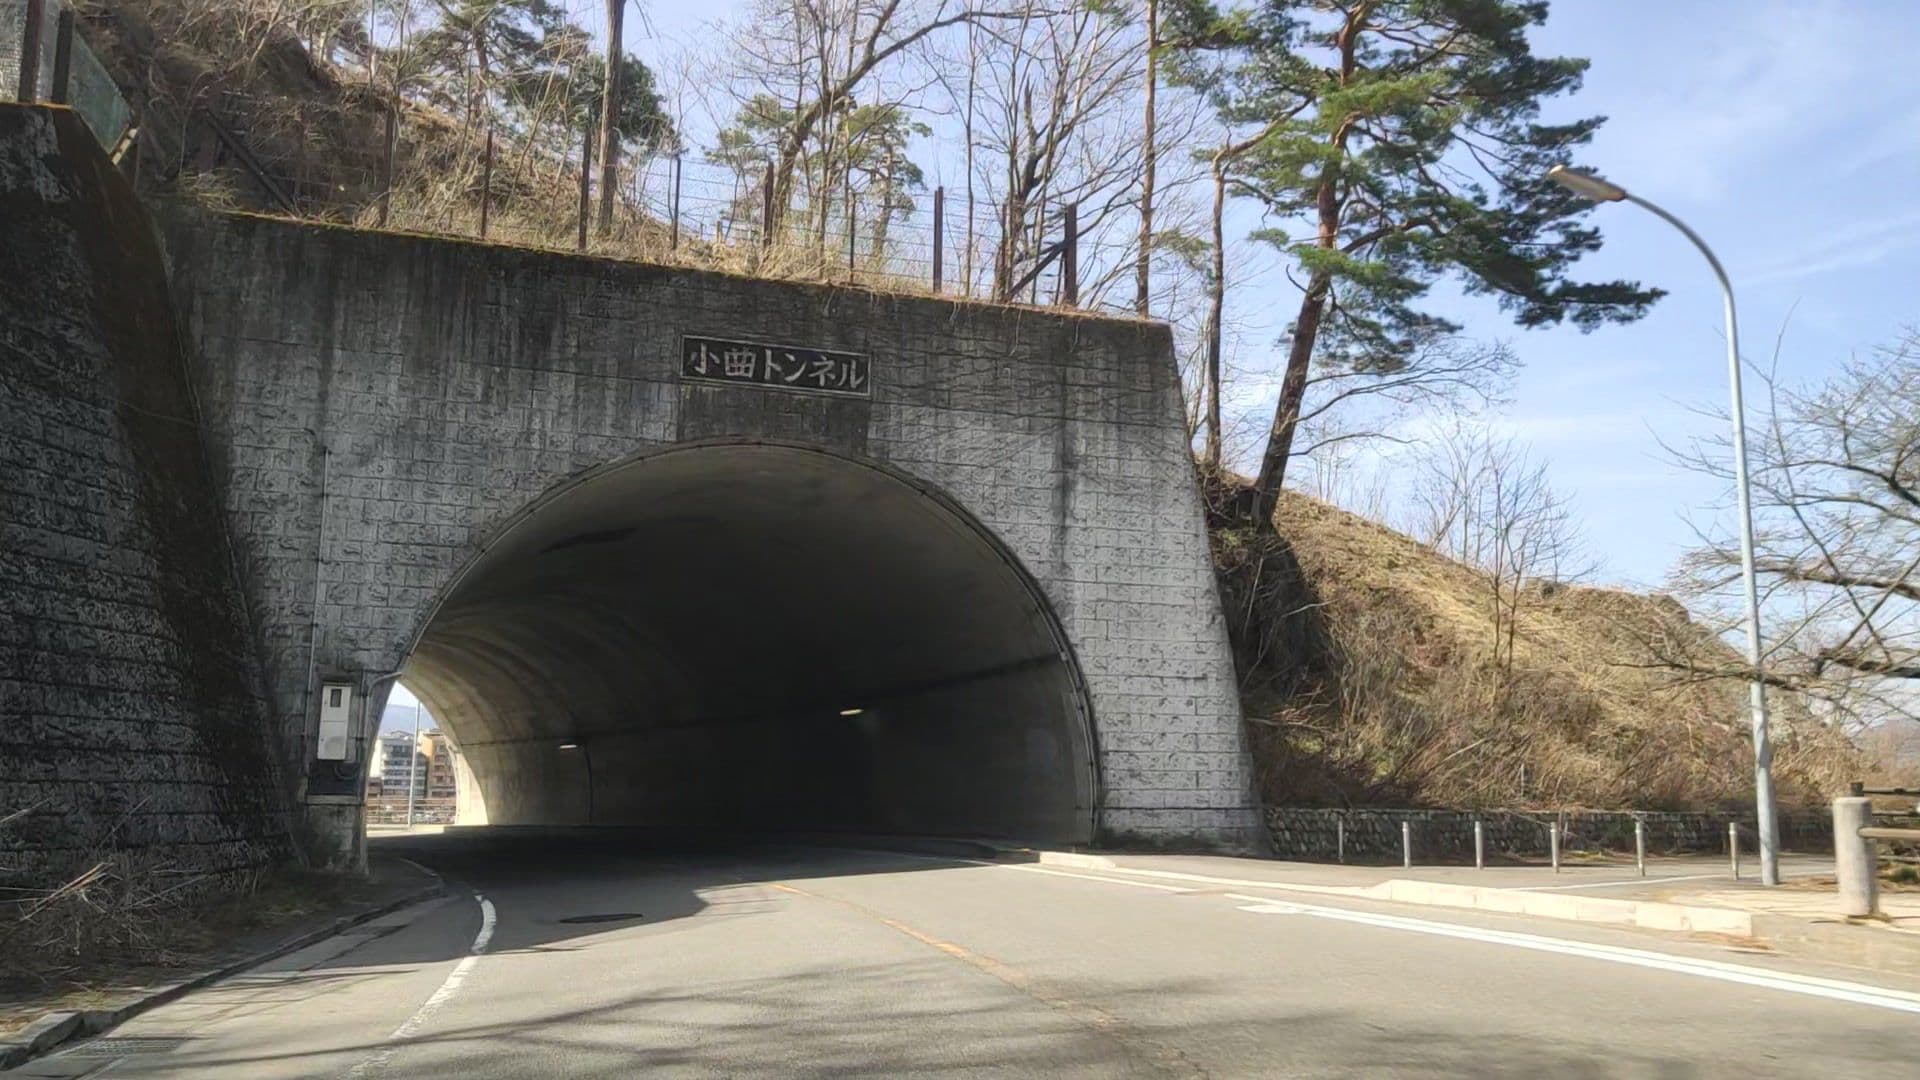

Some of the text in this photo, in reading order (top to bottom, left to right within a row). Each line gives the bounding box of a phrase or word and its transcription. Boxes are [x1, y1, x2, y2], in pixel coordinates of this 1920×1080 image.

[689, 342, 865, 389] 小曲トンネル
